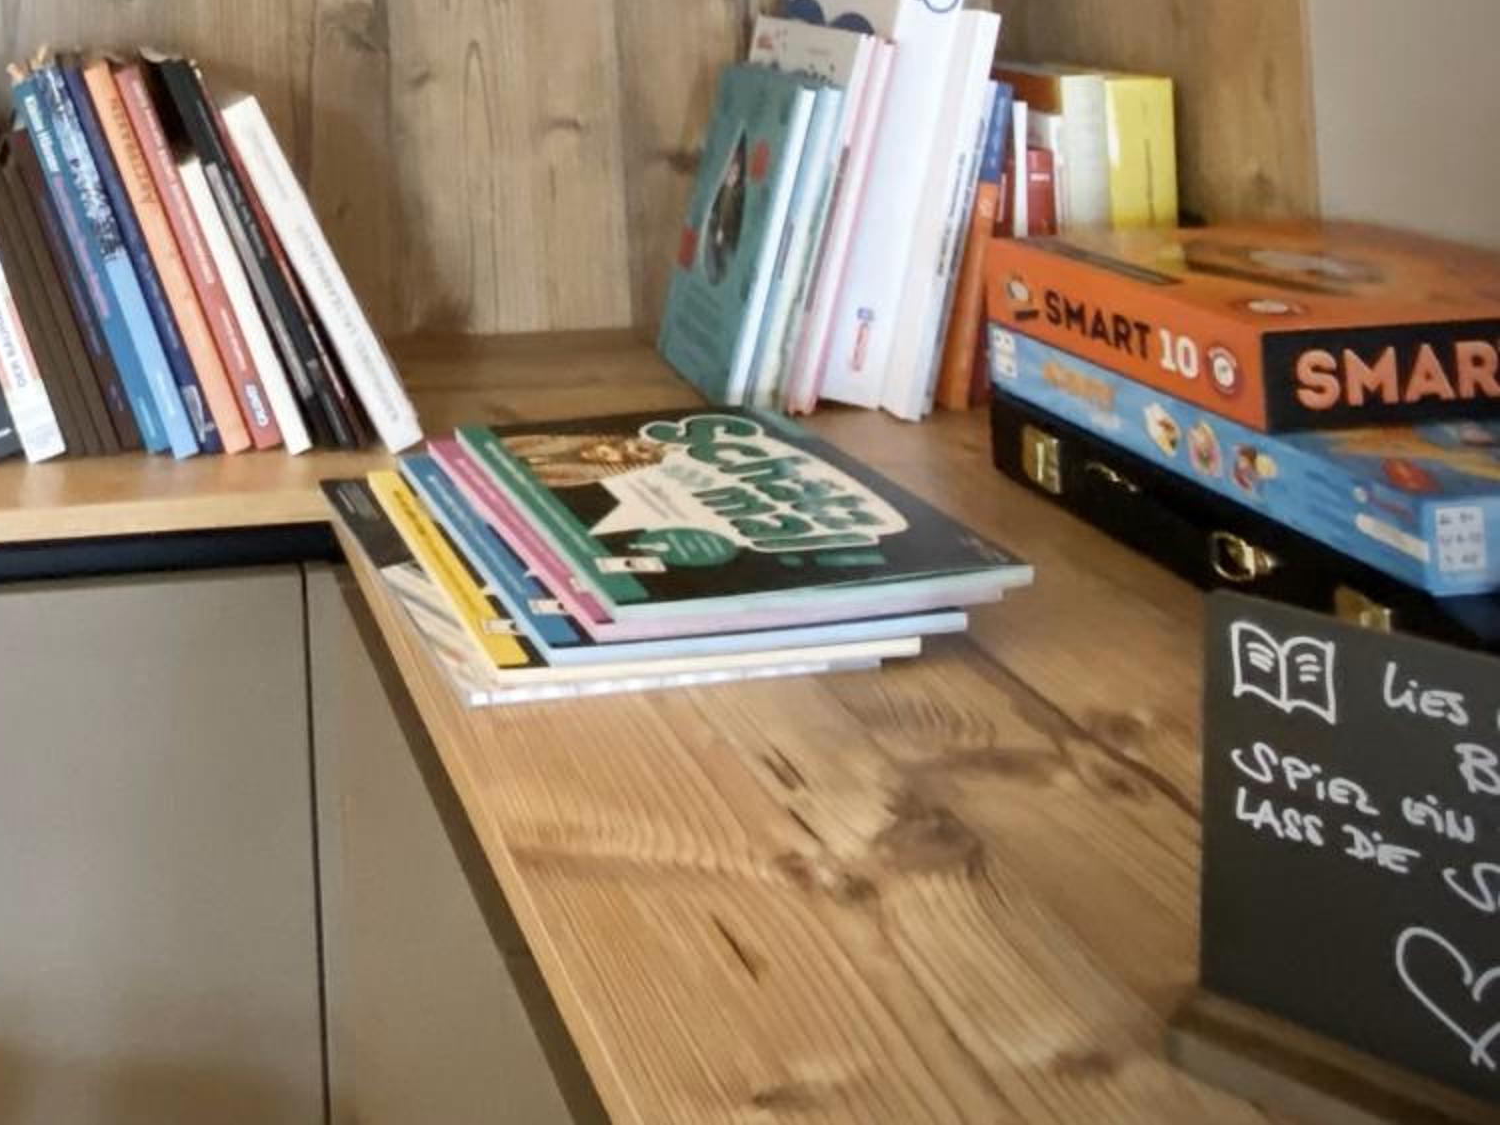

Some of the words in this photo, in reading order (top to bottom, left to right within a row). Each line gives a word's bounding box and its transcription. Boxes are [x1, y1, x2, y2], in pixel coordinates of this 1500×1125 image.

[1045, 289, 1151, 360] SMART
[1159, 327, 1200, 380] 10
[1235, 786, 1325, 847] LASS
[1441, 862, 1500, 913] S
